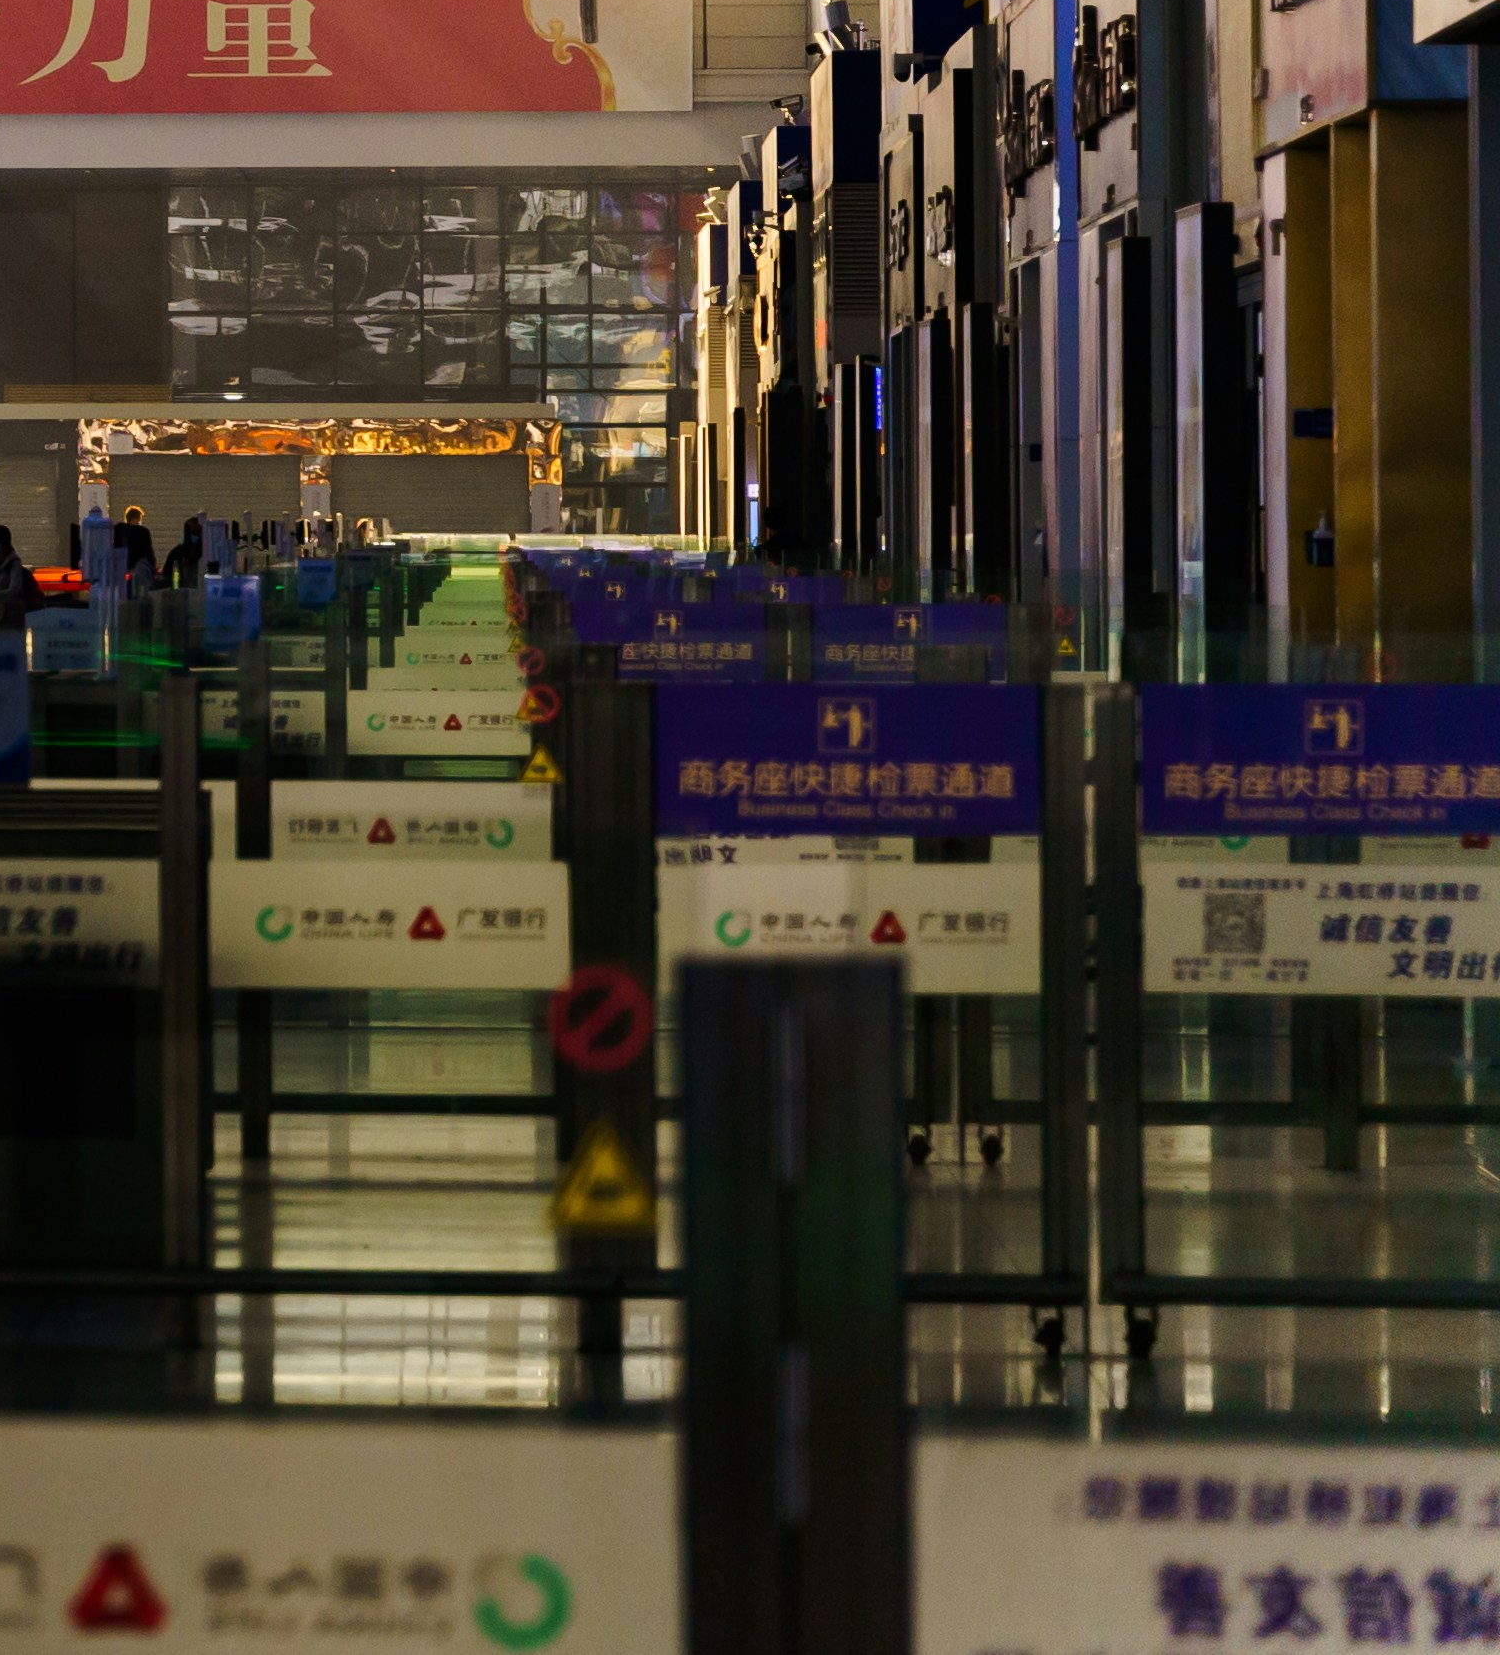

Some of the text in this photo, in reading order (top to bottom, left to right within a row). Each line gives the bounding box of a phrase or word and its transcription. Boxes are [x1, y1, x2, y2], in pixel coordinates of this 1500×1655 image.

[678, 760, 1016, 800] 商务座快捷检票通道
